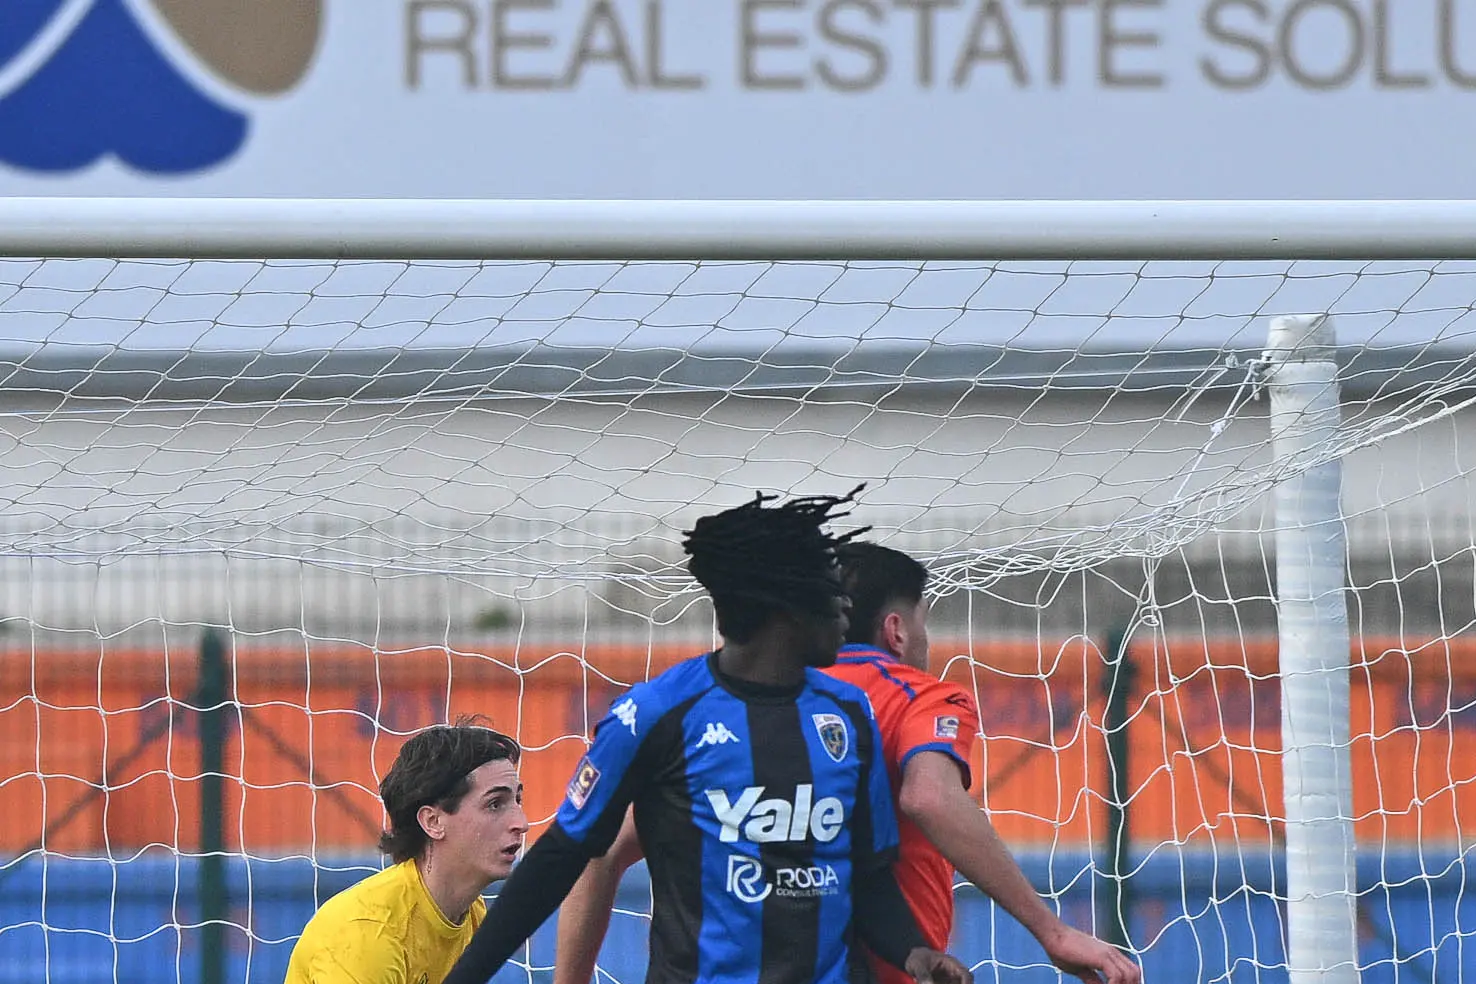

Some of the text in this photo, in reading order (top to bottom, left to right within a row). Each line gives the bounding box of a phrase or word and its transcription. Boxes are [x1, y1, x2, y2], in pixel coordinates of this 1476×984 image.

[404, 0, 705, 91] REAL
[739, 0, 1164, 91] ESTATE
[704, 783, 844, 843] Yale
[776, 864, 839, 889] RODA
